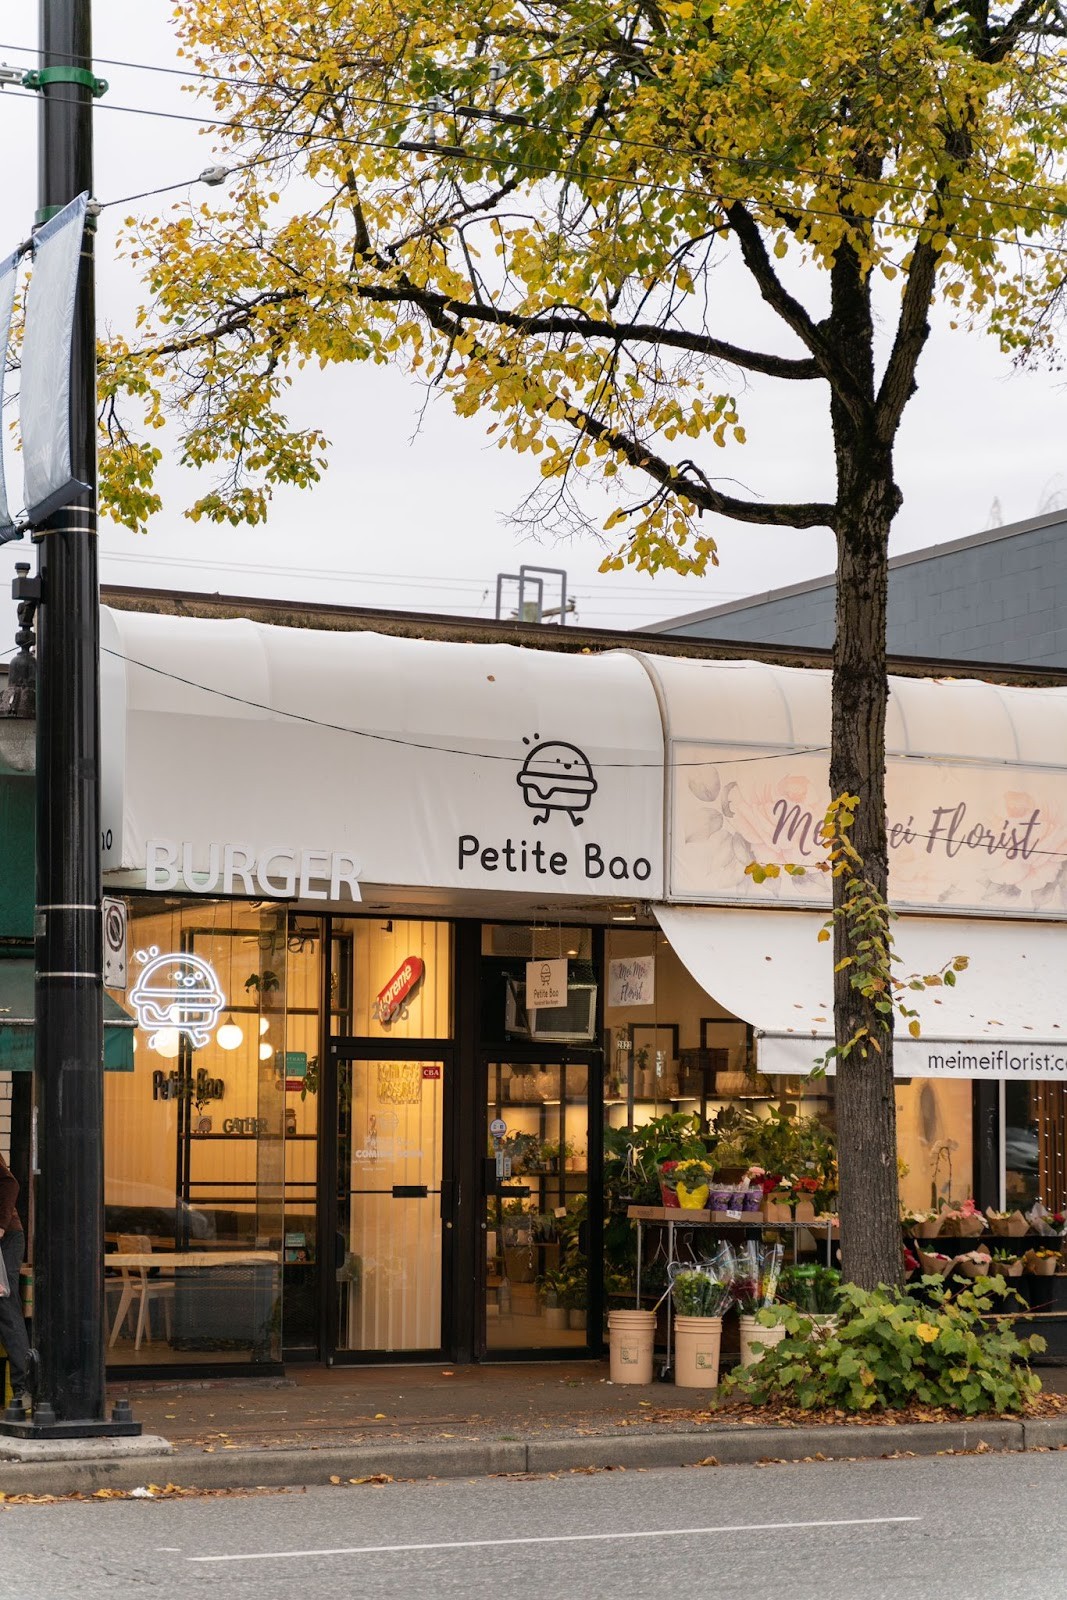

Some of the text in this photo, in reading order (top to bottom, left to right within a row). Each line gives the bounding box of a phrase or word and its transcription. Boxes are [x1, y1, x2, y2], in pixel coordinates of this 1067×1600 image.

[885, 815, 917, 849] ei
[925, 801, 1041, 861] Florist
[145, 838, 363, 903] BURGER
[458, 834, 652, 881] Petite Bao
[534, 988, 559, 999] Petite Bao
[620, 982, 643, 1002] Florist
[153, 1067, 225, 1100] Petite Bao
[222, 1117, 268, 1134] GATHER
